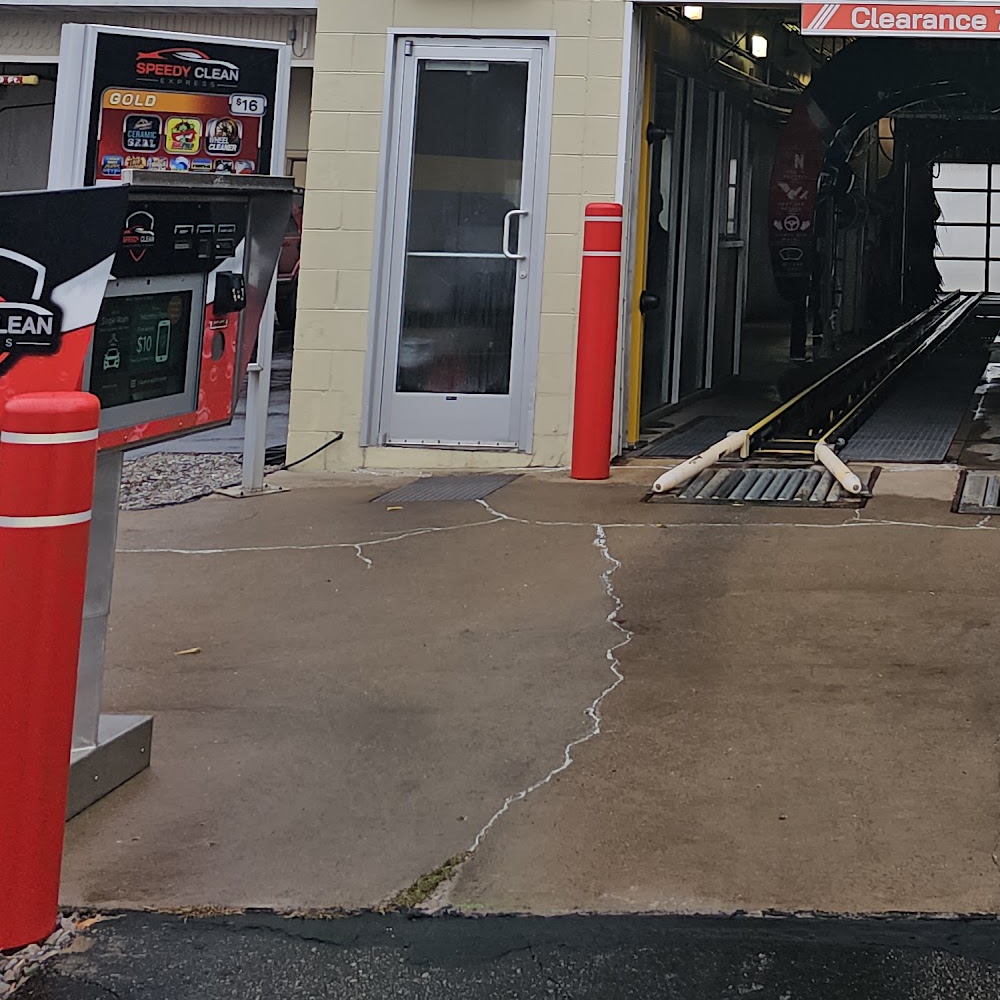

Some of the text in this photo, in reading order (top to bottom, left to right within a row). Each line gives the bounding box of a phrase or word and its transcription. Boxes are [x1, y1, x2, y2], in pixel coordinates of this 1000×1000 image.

[851, 6, 988, 31] Clearance
[136, 62, 240, 82] SPEEDY CLEAN
[159, 77, 216, 88] EXPRESS
[109, 92, 258, 112] GOLD $16
[127, 130, 157, 139] CERAMIC
[136, 335, 152, 354] $10
